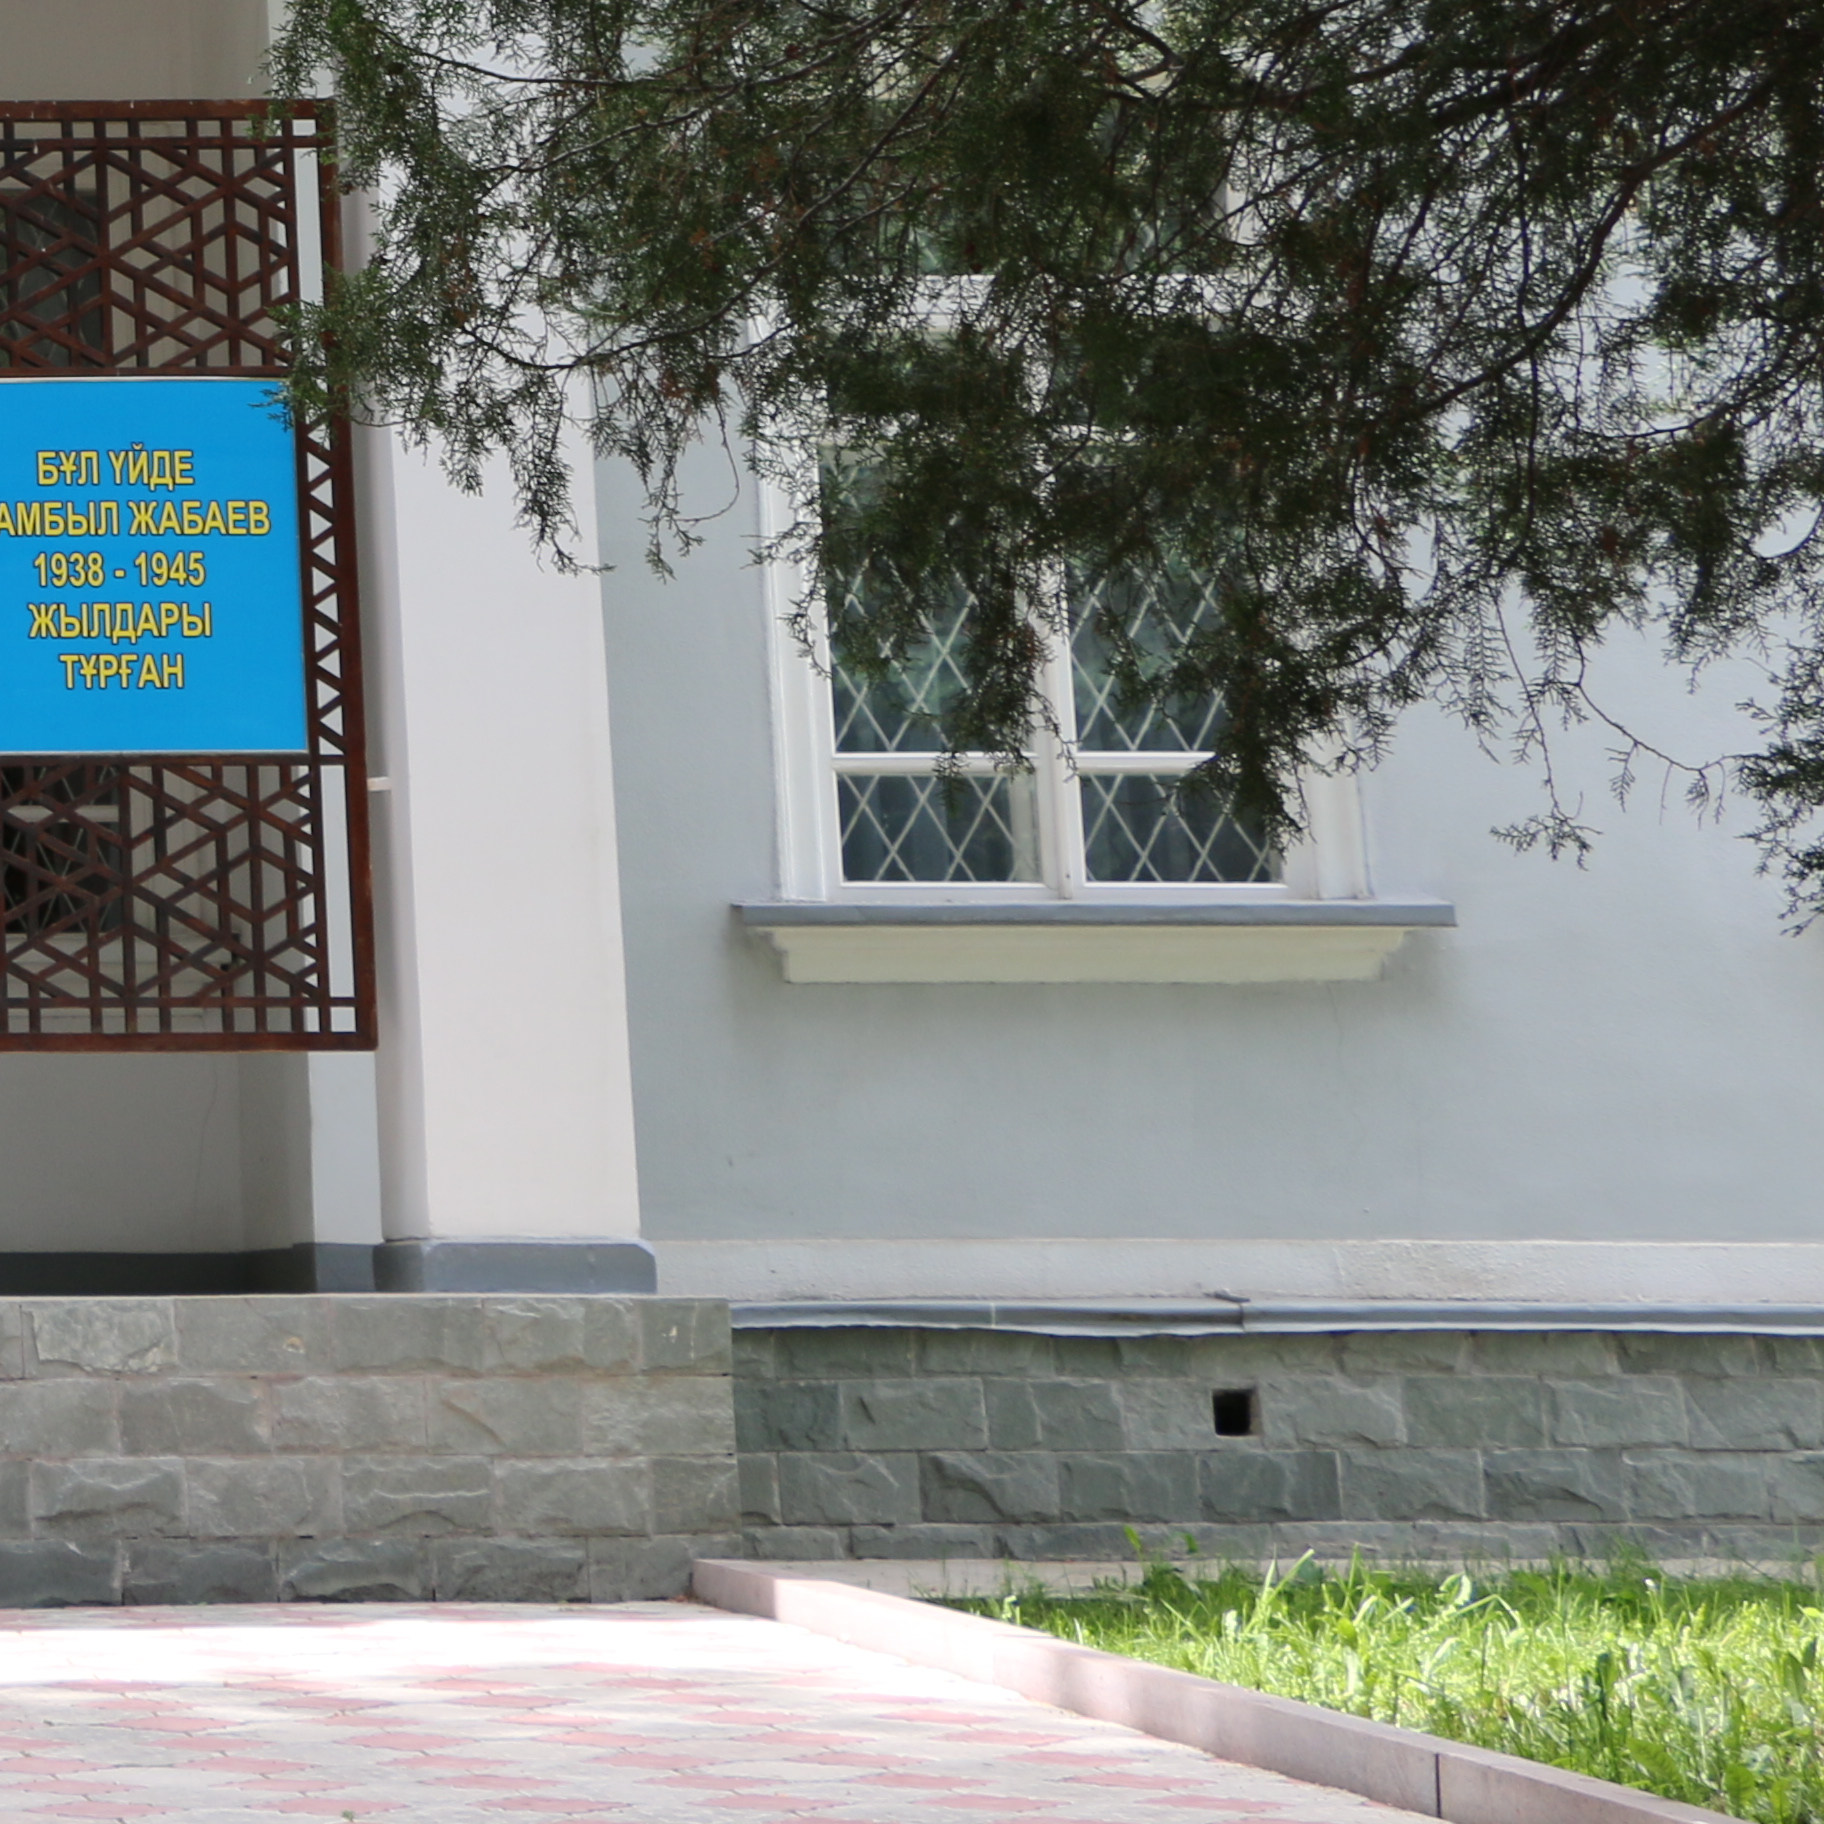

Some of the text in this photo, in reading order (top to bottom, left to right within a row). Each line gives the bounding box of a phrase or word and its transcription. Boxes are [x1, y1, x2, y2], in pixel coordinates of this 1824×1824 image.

[36, 443, 194, 491] БҰЛ ҮЙДЕ
[128, 500, 271, 535] ЖАБАЕВ
[33, 551, 206, 587] 1938 - 1945
[28, 602, 212, 644] ЖЫЛДАРЫ
[59, 653, 184, 689] ТҰРҒАН
